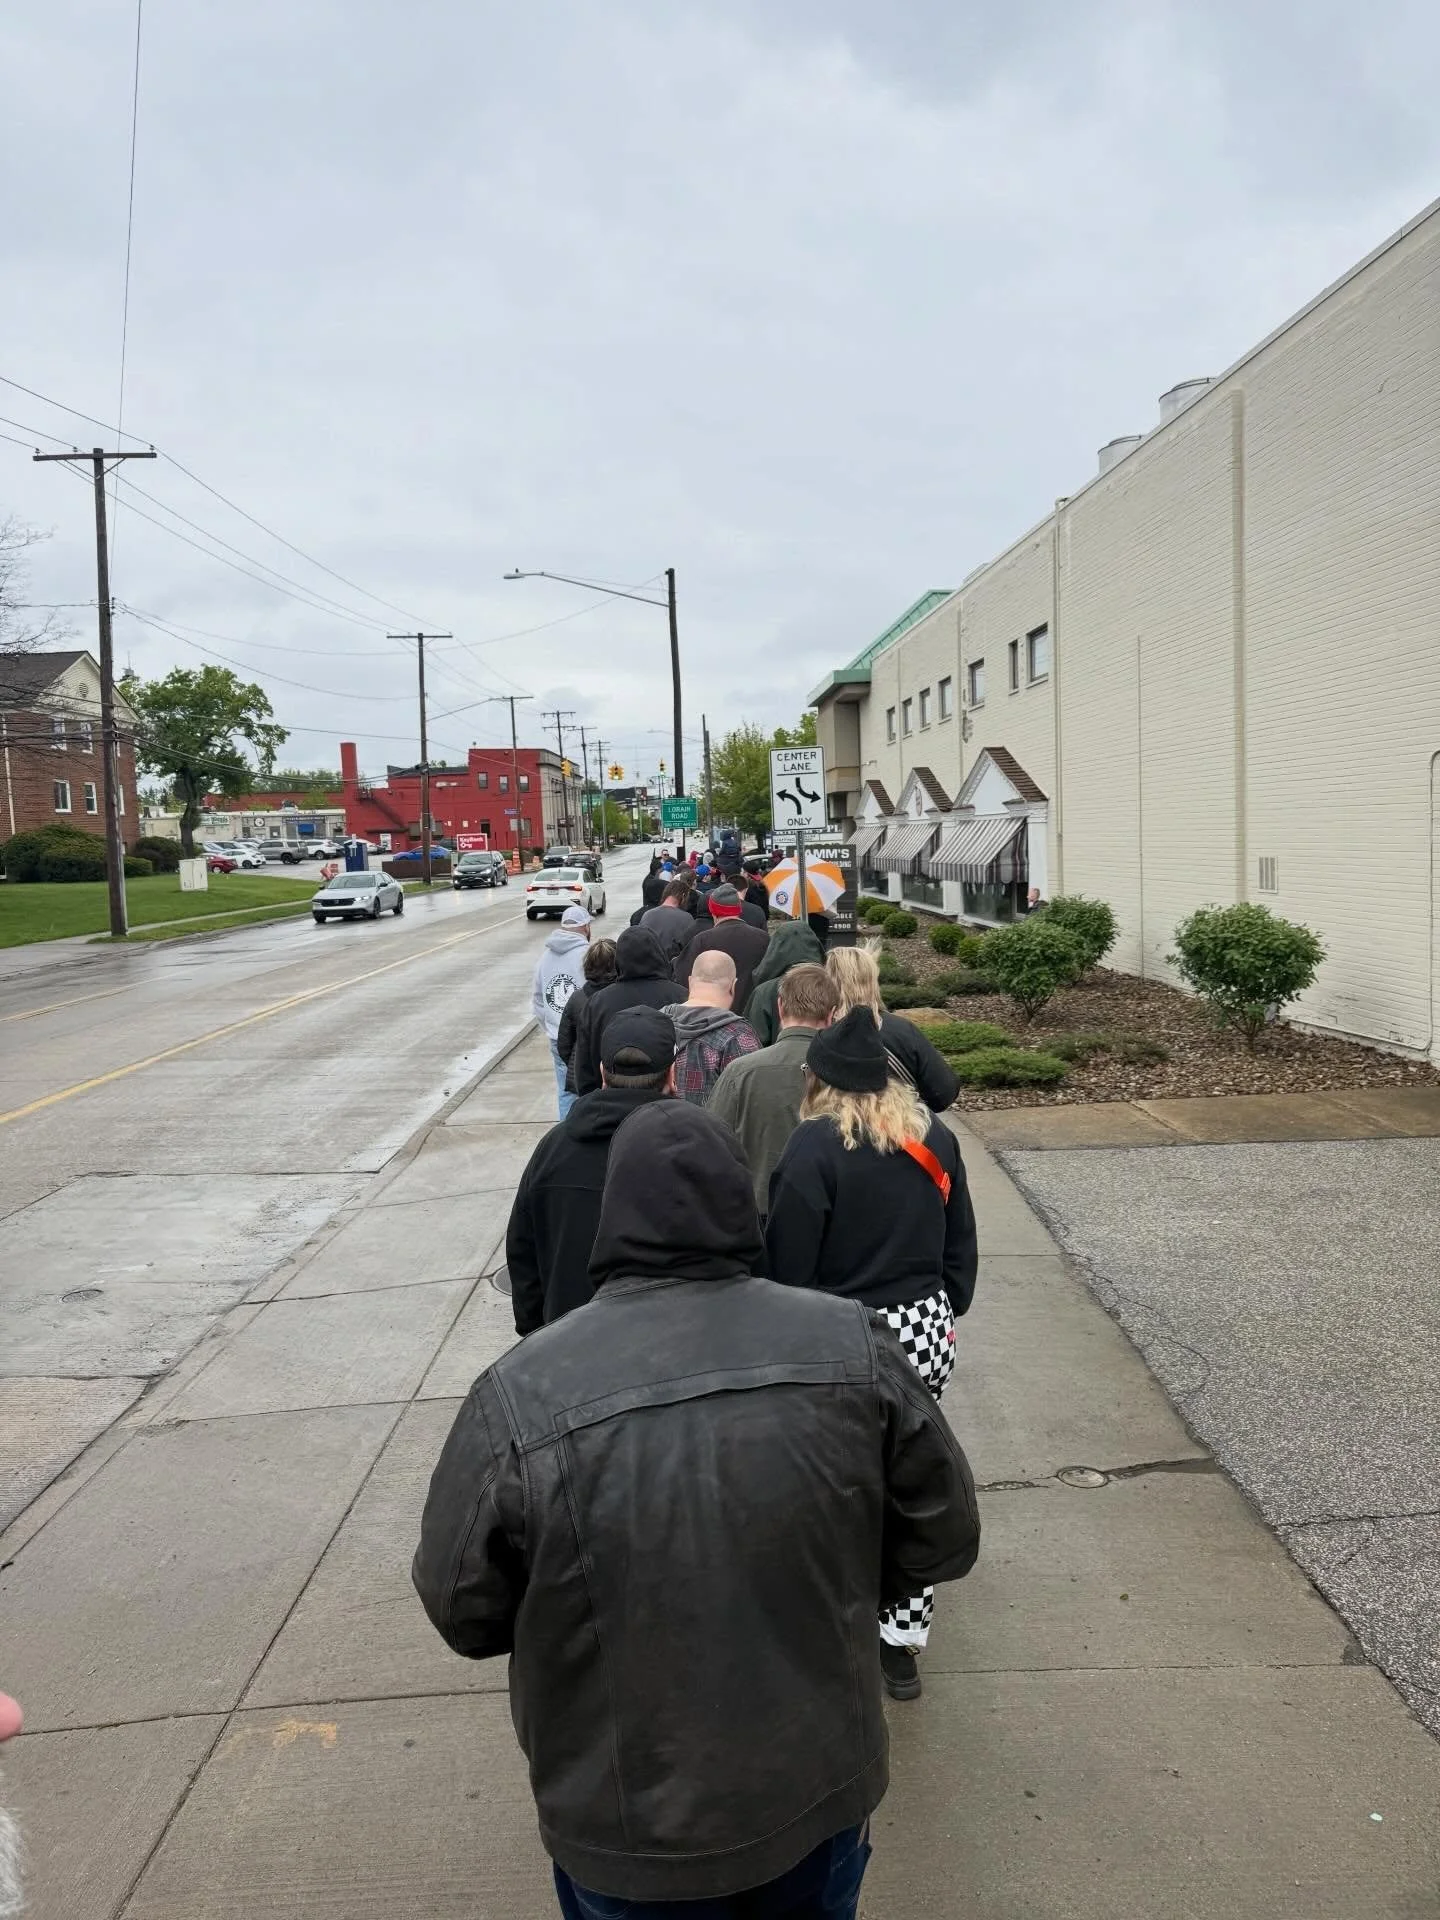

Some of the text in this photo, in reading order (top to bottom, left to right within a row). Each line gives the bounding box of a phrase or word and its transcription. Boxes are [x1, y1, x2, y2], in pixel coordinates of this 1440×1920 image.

[776, 751, 817, 762] CENTER
[783, 762, 812, 771] LANE
[787, 817, 813, 826] ONLY
